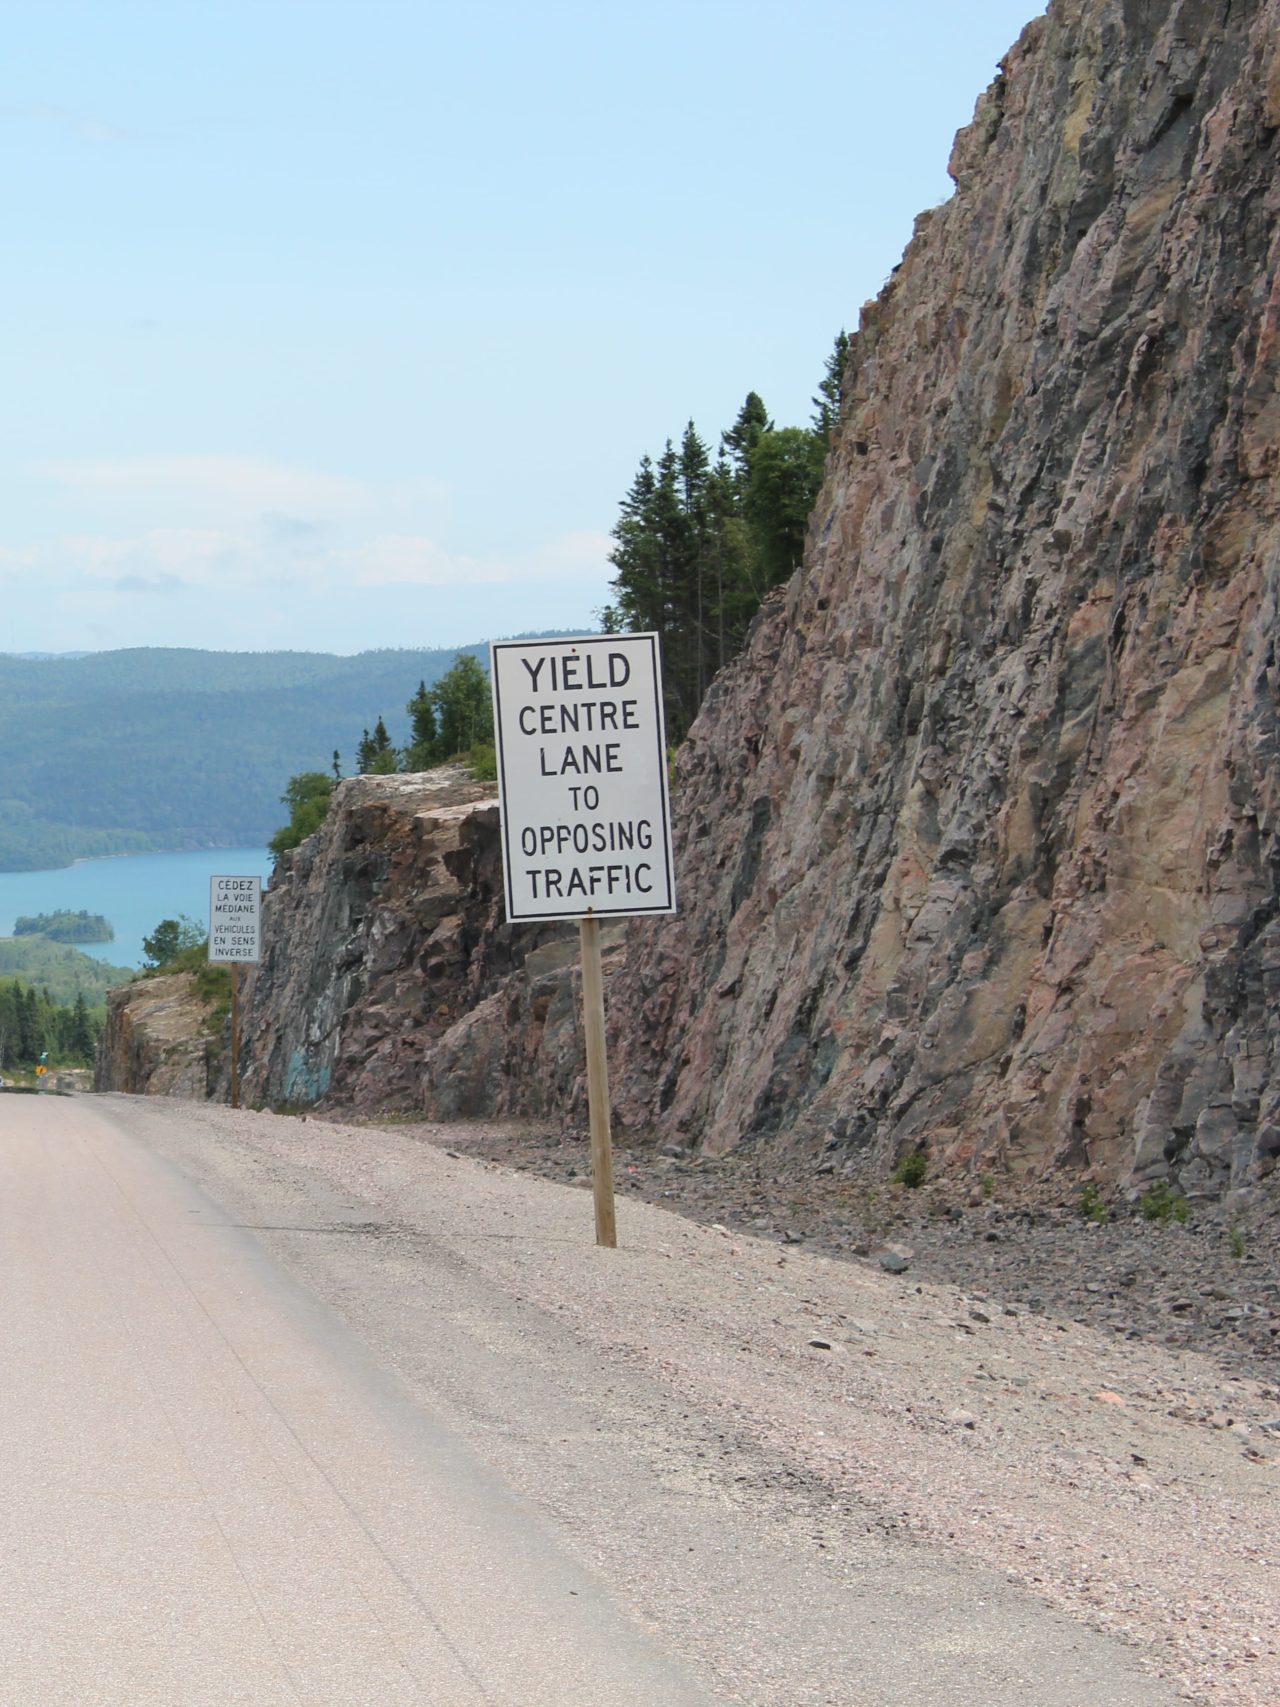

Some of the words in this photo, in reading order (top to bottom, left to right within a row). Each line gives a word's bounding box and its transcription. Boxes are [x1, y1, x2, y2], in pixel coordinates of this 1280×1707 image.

[520, 653, 631, 693] YIELD
[519, 700, 640, 736] CENTRE
[540, 743, 623, 776] LANE
[568, 785, 600, 811] TO
[521, 819, 653, 857] OPPOSING
[217, 893, 229, 902] LA
[233, 893, 254, 902] VOIE
[526, 863, 653, 899] TRAFFIC
[213, 936, 226, 945] EN
[231, 936, 255, 945] SENS
[215, 948, 254, 957] INVERSE
